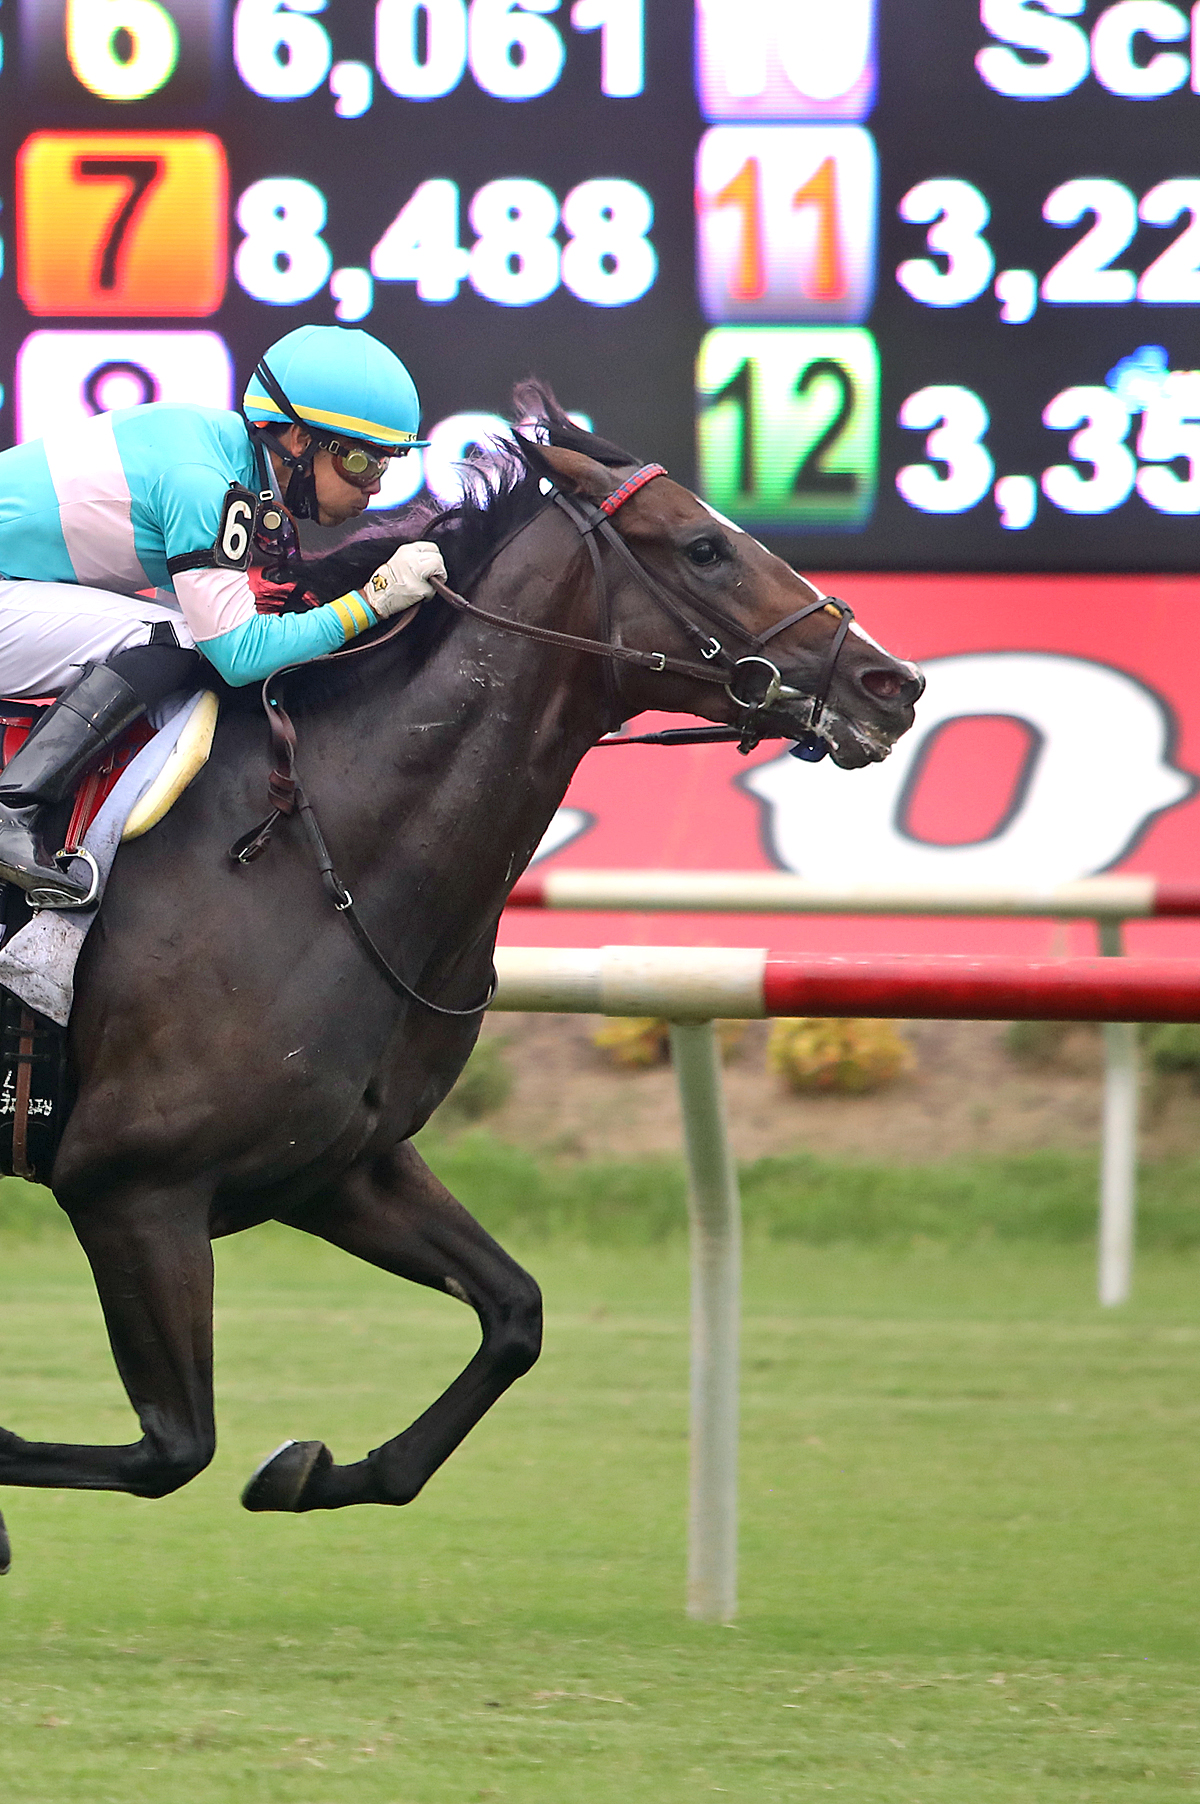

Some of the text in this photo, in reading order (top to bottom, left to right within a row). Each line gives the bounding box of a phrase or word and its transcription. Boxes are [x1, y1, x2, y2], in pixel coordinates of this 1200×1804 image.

[67, 0, 646, 118] 6 6,061
[974, 0, 1200, 101] Sc
[72, 155, 658, 321] 7 8,488
[708, 156, 848, 301] 11
[700, 357, 861, 496] 12
[222, 500, 252, 561] 6
